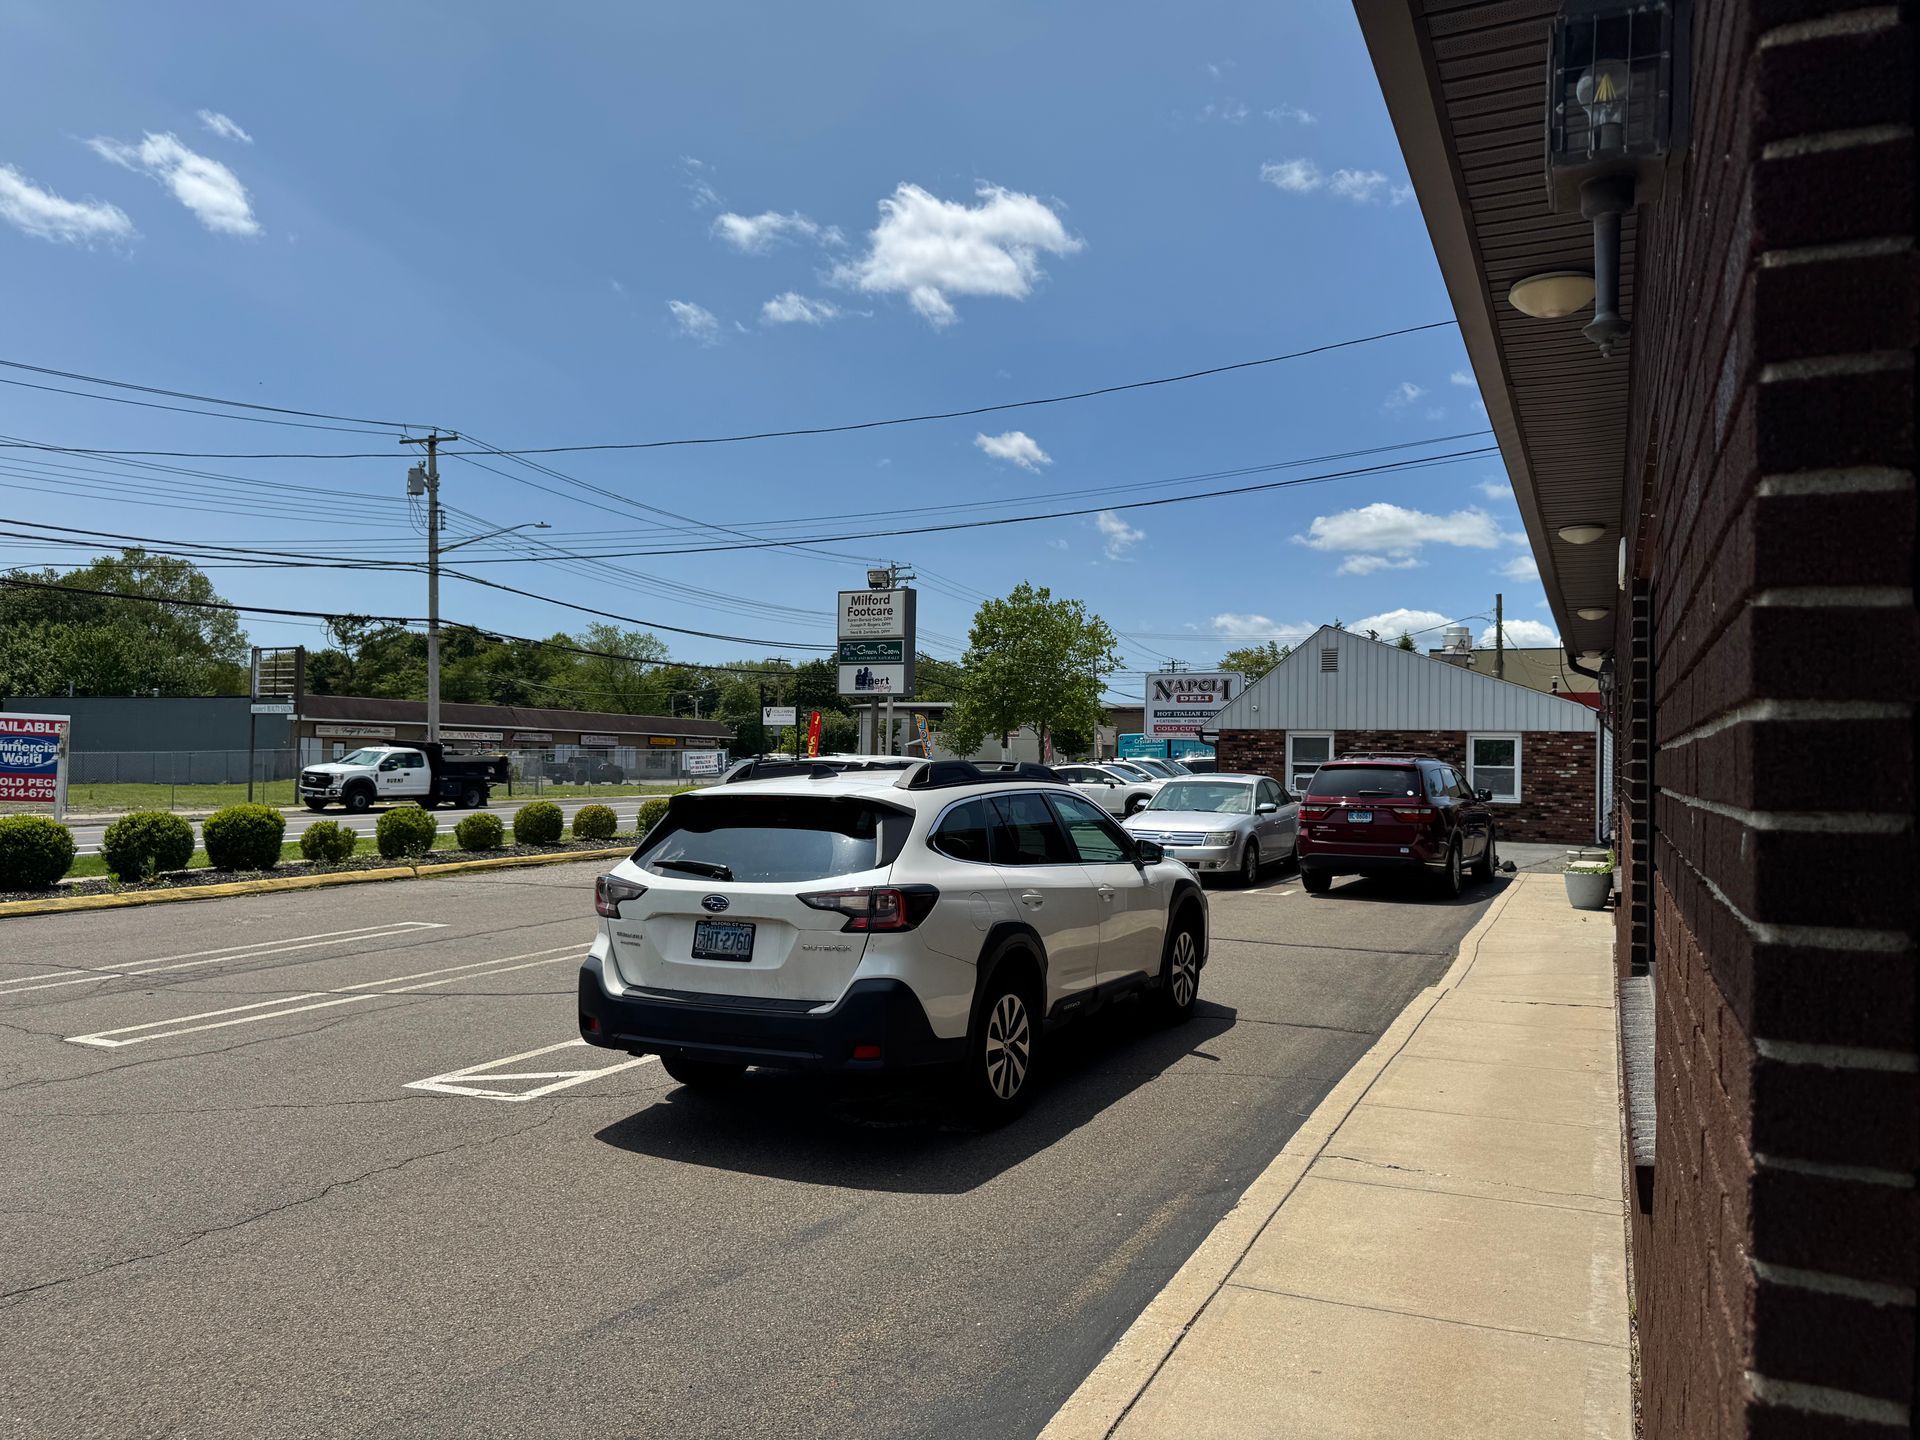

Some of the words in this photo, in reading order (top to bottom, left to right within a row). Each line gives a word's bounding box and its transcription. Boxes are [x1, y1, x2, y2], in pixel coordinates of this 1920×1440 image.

[851, 594, 891, 606] Milford
[847, 607, 894, 617] Footcare
[857, 644, 878, 655] Green
[877, 644, 900, 655] Room
[1153, 679, 1233, 702] NAPOLI
[2, 752, 42, 763] World
[0, 788, 56, 798] 314-679
[801, 943, 853, 952] OUTBACK
